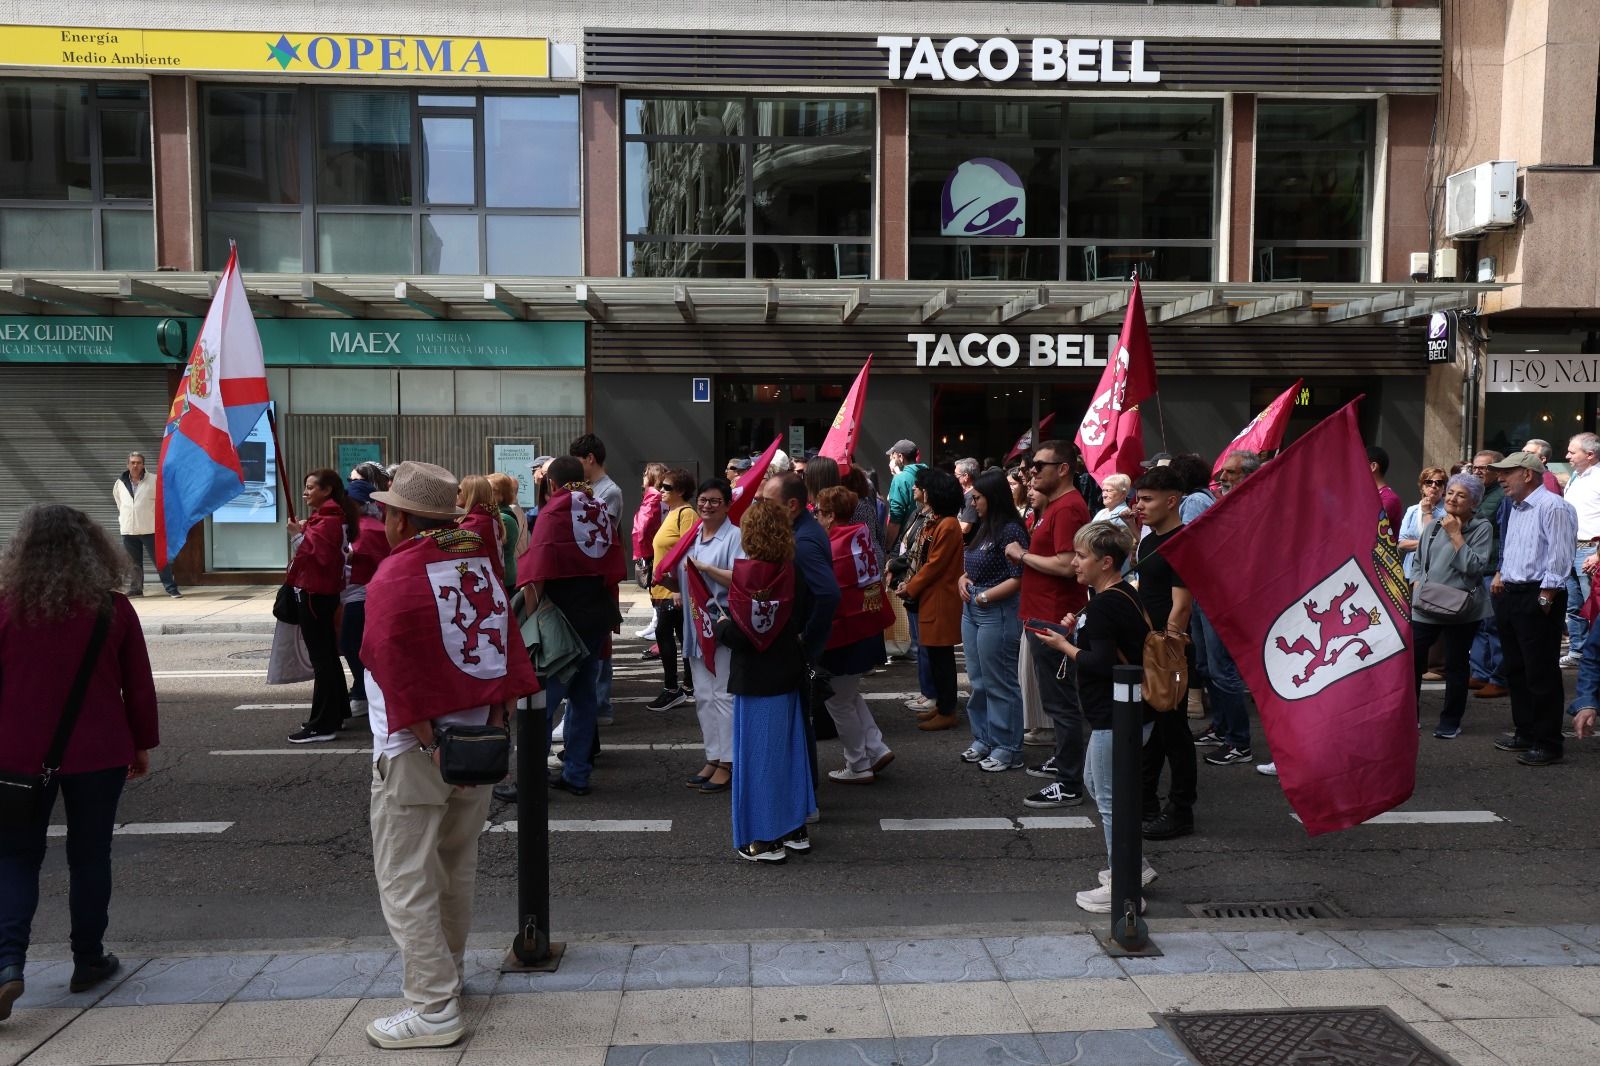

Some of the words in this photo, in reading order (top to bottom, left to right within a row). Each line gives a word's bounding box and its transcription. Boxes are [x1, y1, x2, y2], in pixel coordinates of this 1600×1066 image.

[60, 30, 119, 46] Energía
[62, 51, 107, 64] Medio
[111, 53, 181, 66] Ambiente
[307, 36, 491, 73] OPEMA
[876, 36, 1020, 82] TACO
[1031, 38, 1161, 83] BELL
[34, 324, 114, 342] CLIDENIN
[23, 344, 64, 355] DENTAL
[67, 345, 113, 356] INTEGRAL
[330, 331, 401, 354] MAEX
[907, 332, 1020, 368] TACO
[1427, 340, 1448, 351] TACO
[1428, 350, 1447, 361] BELL
